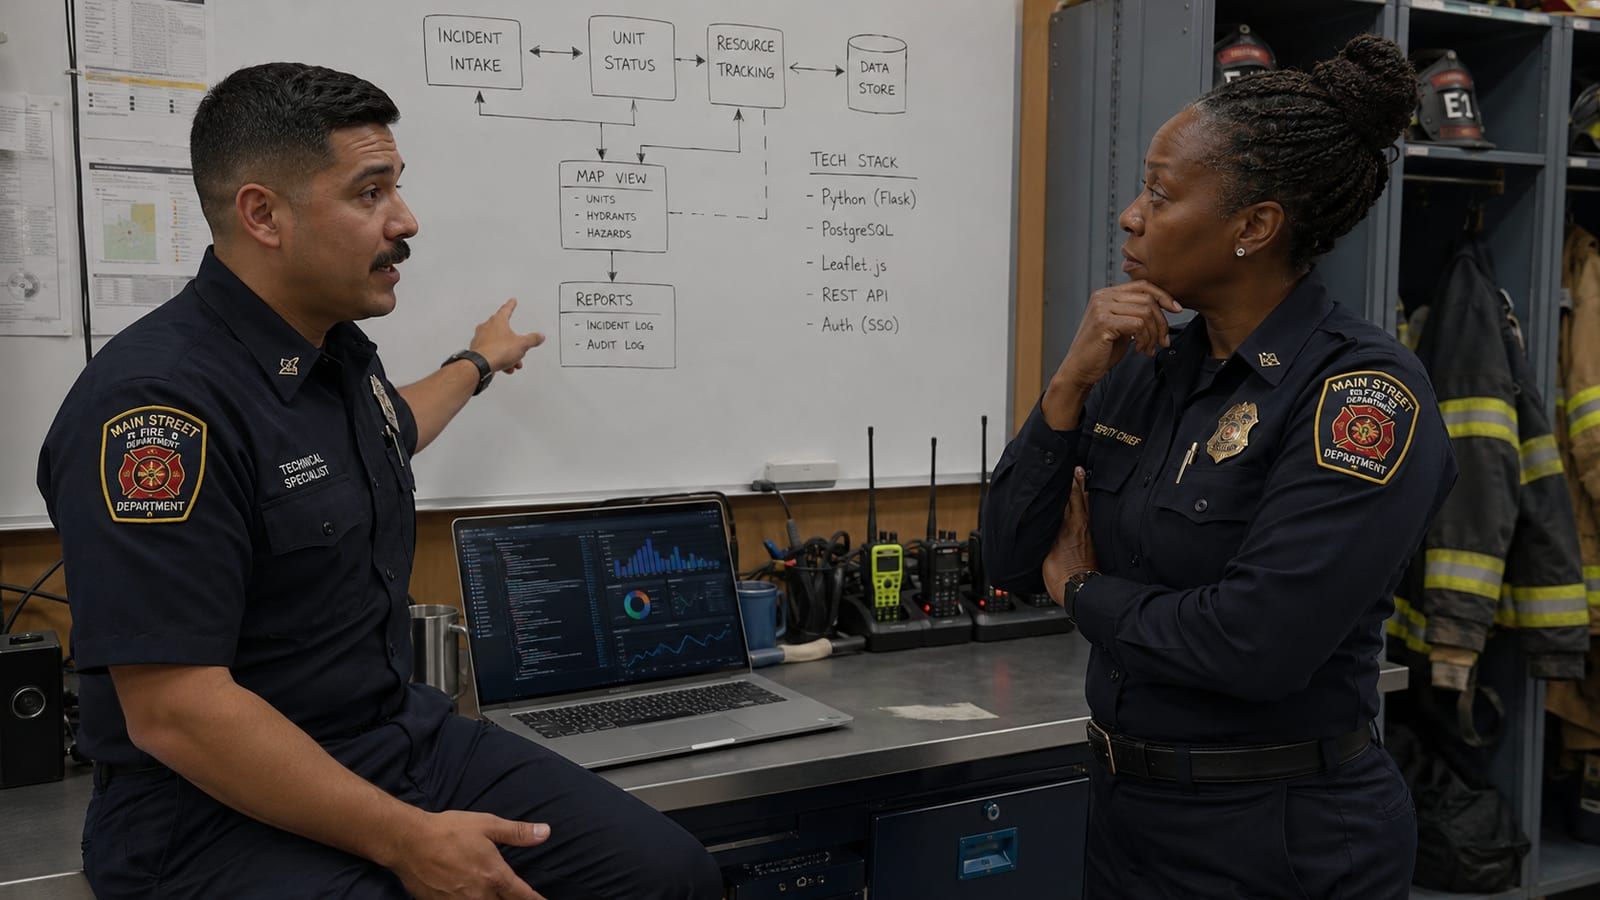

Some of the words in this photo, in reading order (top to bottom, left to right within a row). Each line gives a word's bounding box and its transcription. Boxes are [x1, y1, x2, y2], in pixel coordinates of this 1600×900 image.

[438, 27, 502, 45] INCIDENT
[613, 31, 645, 45] UNIT
[717, 35, 775, 52] RESOURCE
[451, 56, 502, 72] INTAKE
[605, 55, 656, 72] STATUS
[716, 62, 775, 79] TRACKING
[860, 61, 889, 73] DATA
[859, 82, 895, 95] STORE
[1444, 93, 1473, 118] E1
[810, 151, 846, 166] TECH
[858, 154, 898, 168] STACK
[576, 169, 604, 183] MAP
[616, 172, 647, 184] VIEW
[586, 195, 615, 204] UNITS
[822, 188, 866, 211] Python
[874, 188, 917, 210] (Flask)
[586, 211, 636, 221] HYDRANTS
[587, 228, 631, 238] HAZARDS
[822, 220, 894, 243] PostgreSQL
[822, 255, 887, 277] Leaflet.js
[576, 292, 633, 306] REPORTS
[823, 287, 857, 302] REST
[866, 289, 888, 302] API
[587, 320, 629, 330] INCIDENT
[635, 322, 653, 330] LOG
[822, 316, 853, 332] Auth
[861, 316, 899, 334] (SSO)
[587, 339, 616, 349] AUDIT
[625, 340, 644, 350] LOG
[1332, 378, 1367, 392] MAIN
[1372, 379, 1414, 412] STREET
[110, 416, 144, 437] MAIN
[149, 415, 200, 437] STREET
[140, 428, 165, 437] FIRE
[284, 465, 330, 488] SPECIALIST
[116, 501, 185, 511] DEPARTMENT
